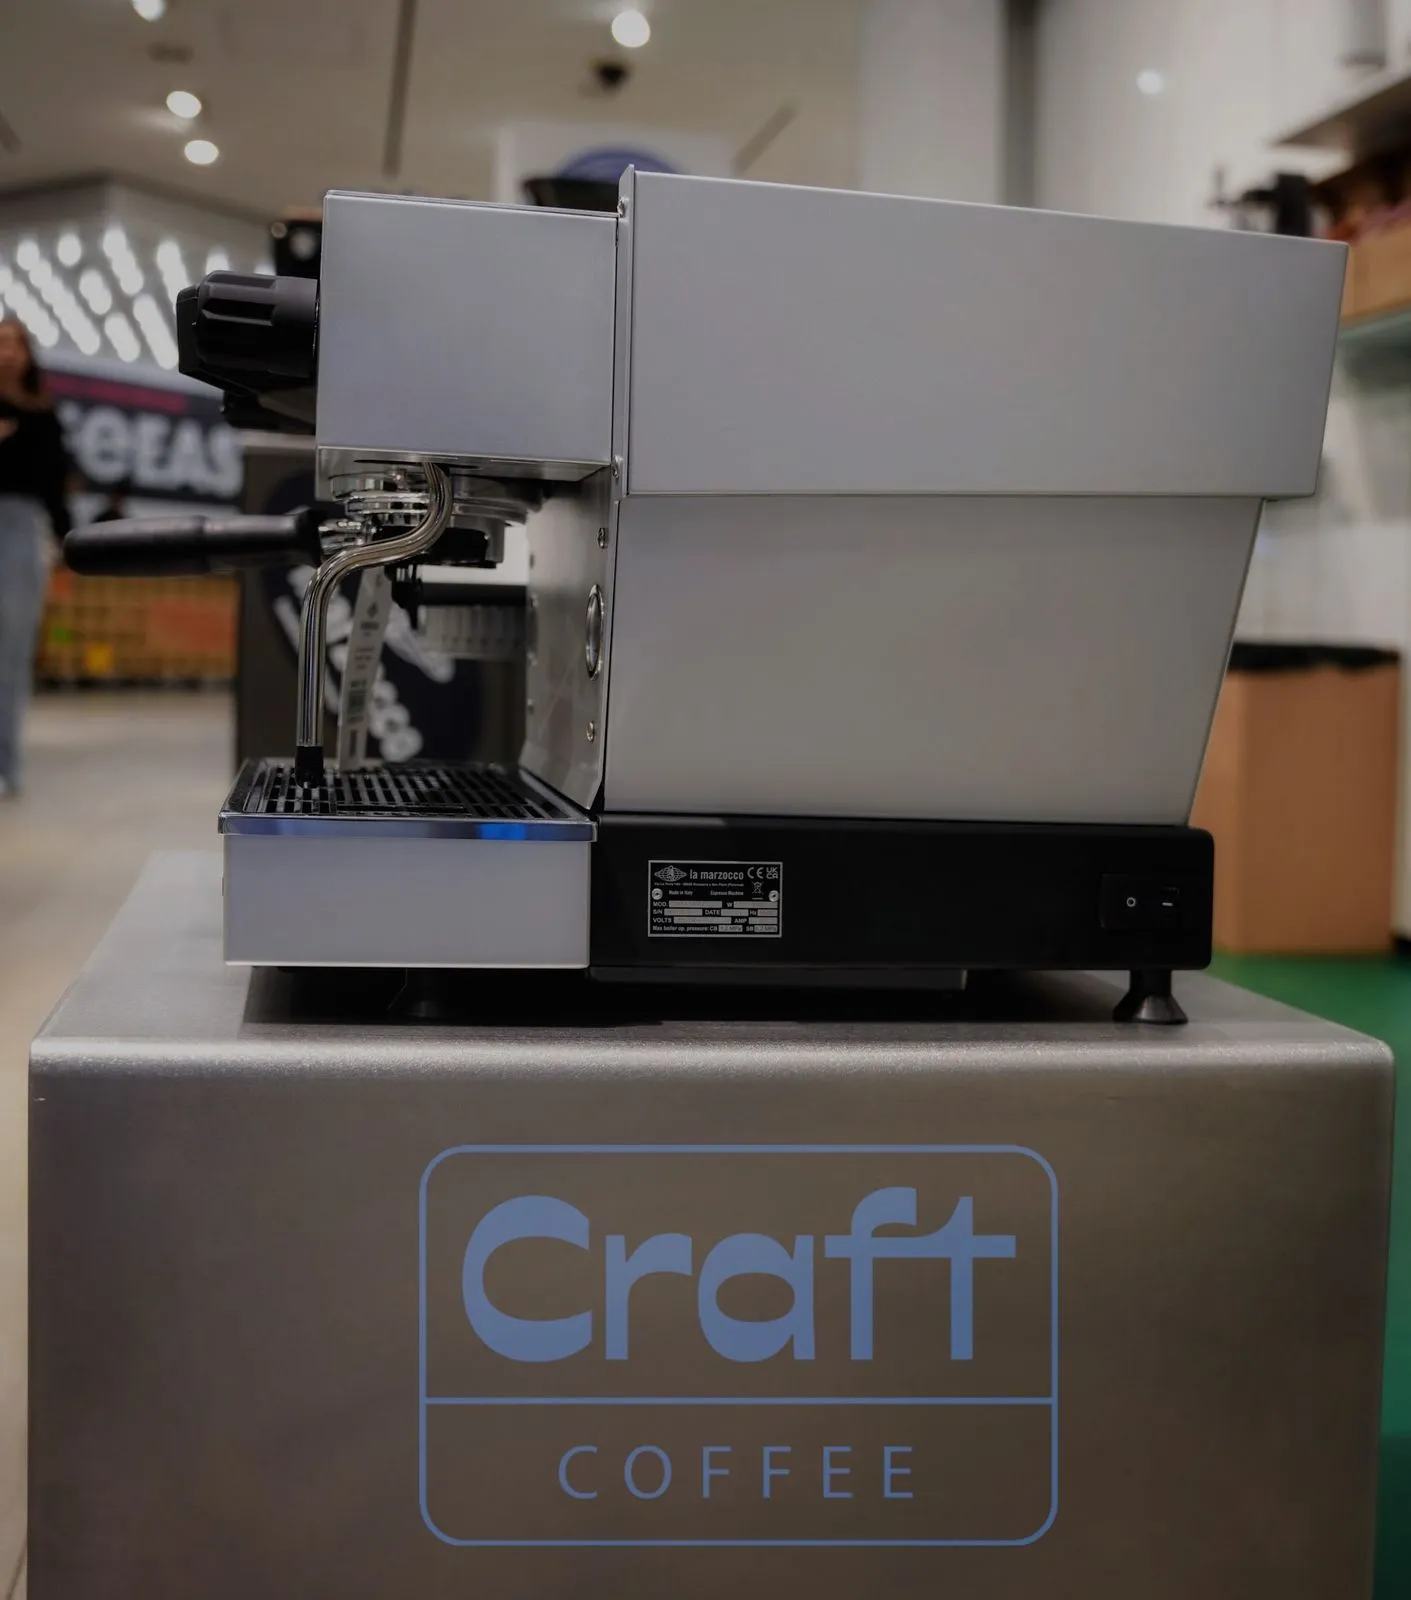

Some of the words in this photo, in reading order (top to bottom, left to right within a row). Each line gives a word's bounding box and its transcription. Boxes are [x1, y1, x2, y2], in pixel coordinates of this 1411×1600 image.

[689, 868, 698, 880] la
[700, 870, 744, 880] marzocco
[461, 1186, 1017, 1363] Craft
[557, 1444, 914, 1500] COFFEE
